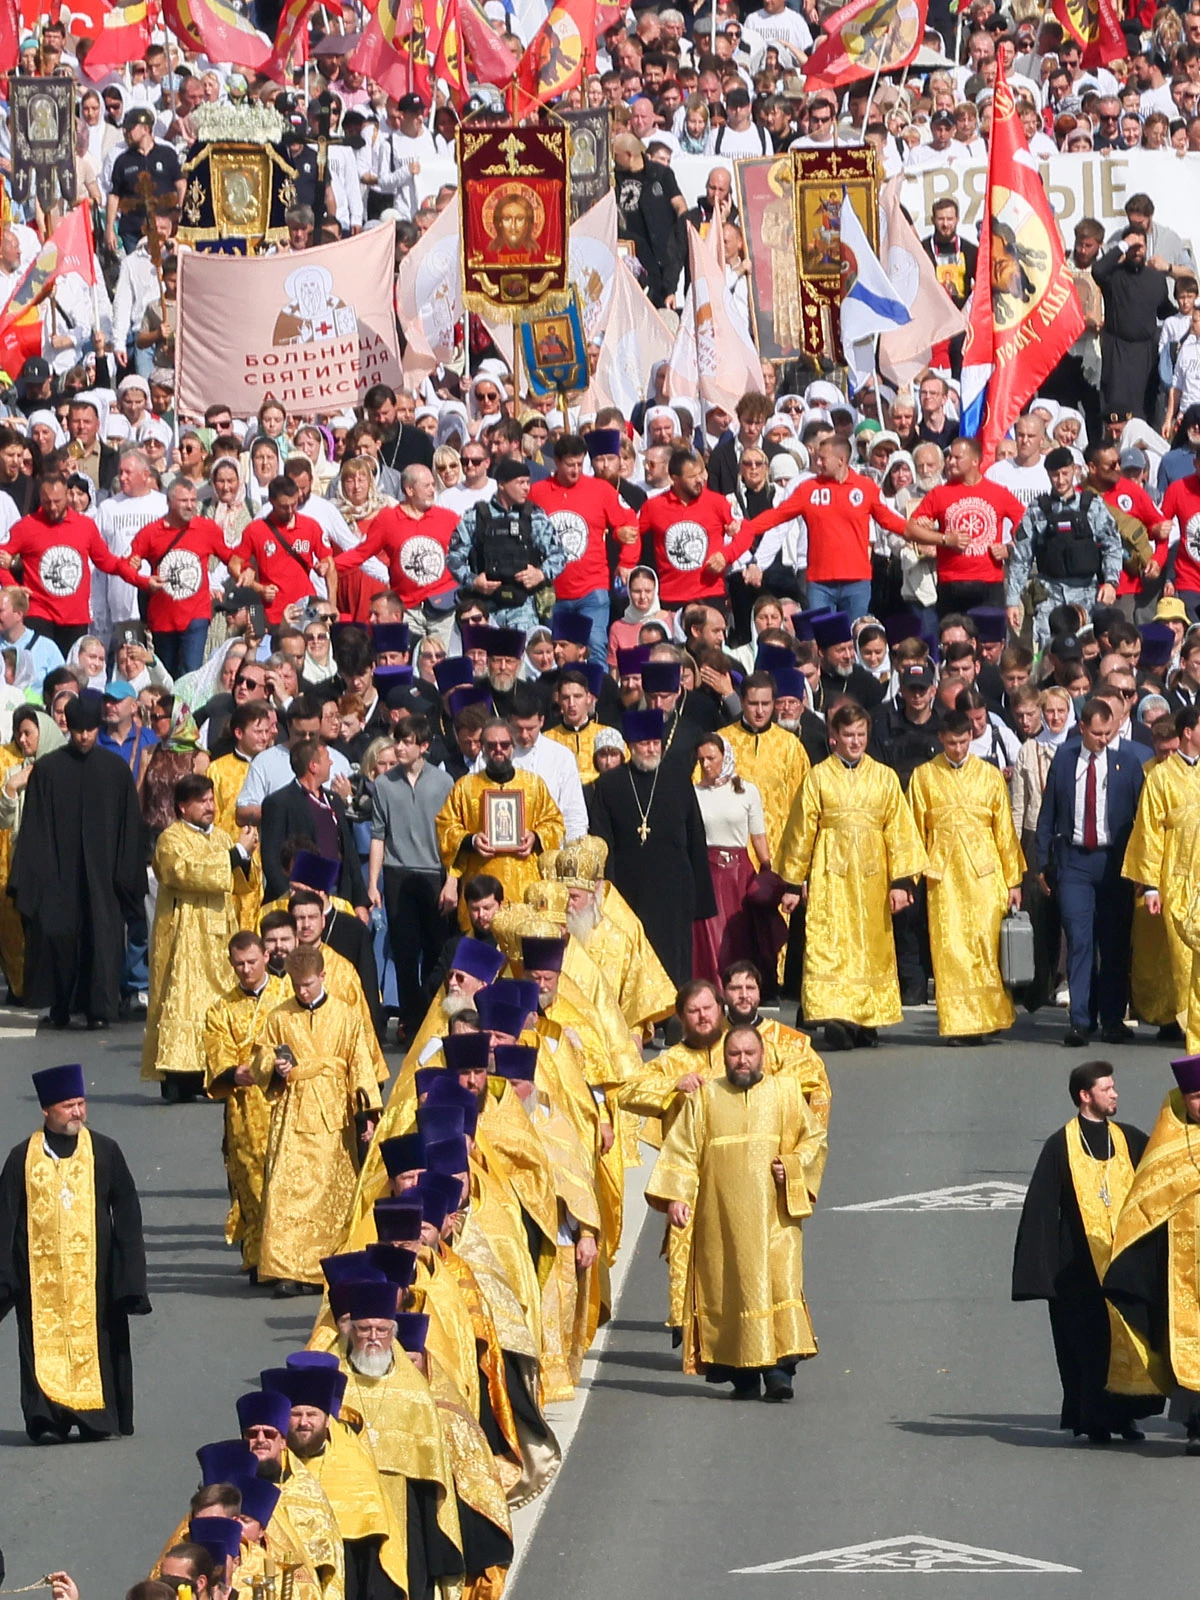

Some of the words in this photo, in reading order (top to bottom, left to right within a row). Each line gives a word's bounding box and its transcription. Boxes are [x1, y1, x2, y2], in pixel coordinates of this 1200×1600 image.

[903, 158, 1129, 227] ВЯЫЕ
[245, 333, 385, 367] БОЛЬНИЦА
[243, 349, 390, 386] СВЯТИТЕЛЯ
[263, 371, 383, 402] АЛЕКСИЯ
[809, 487, 831, 507] 40
[291, 538, 310, 553] 40
